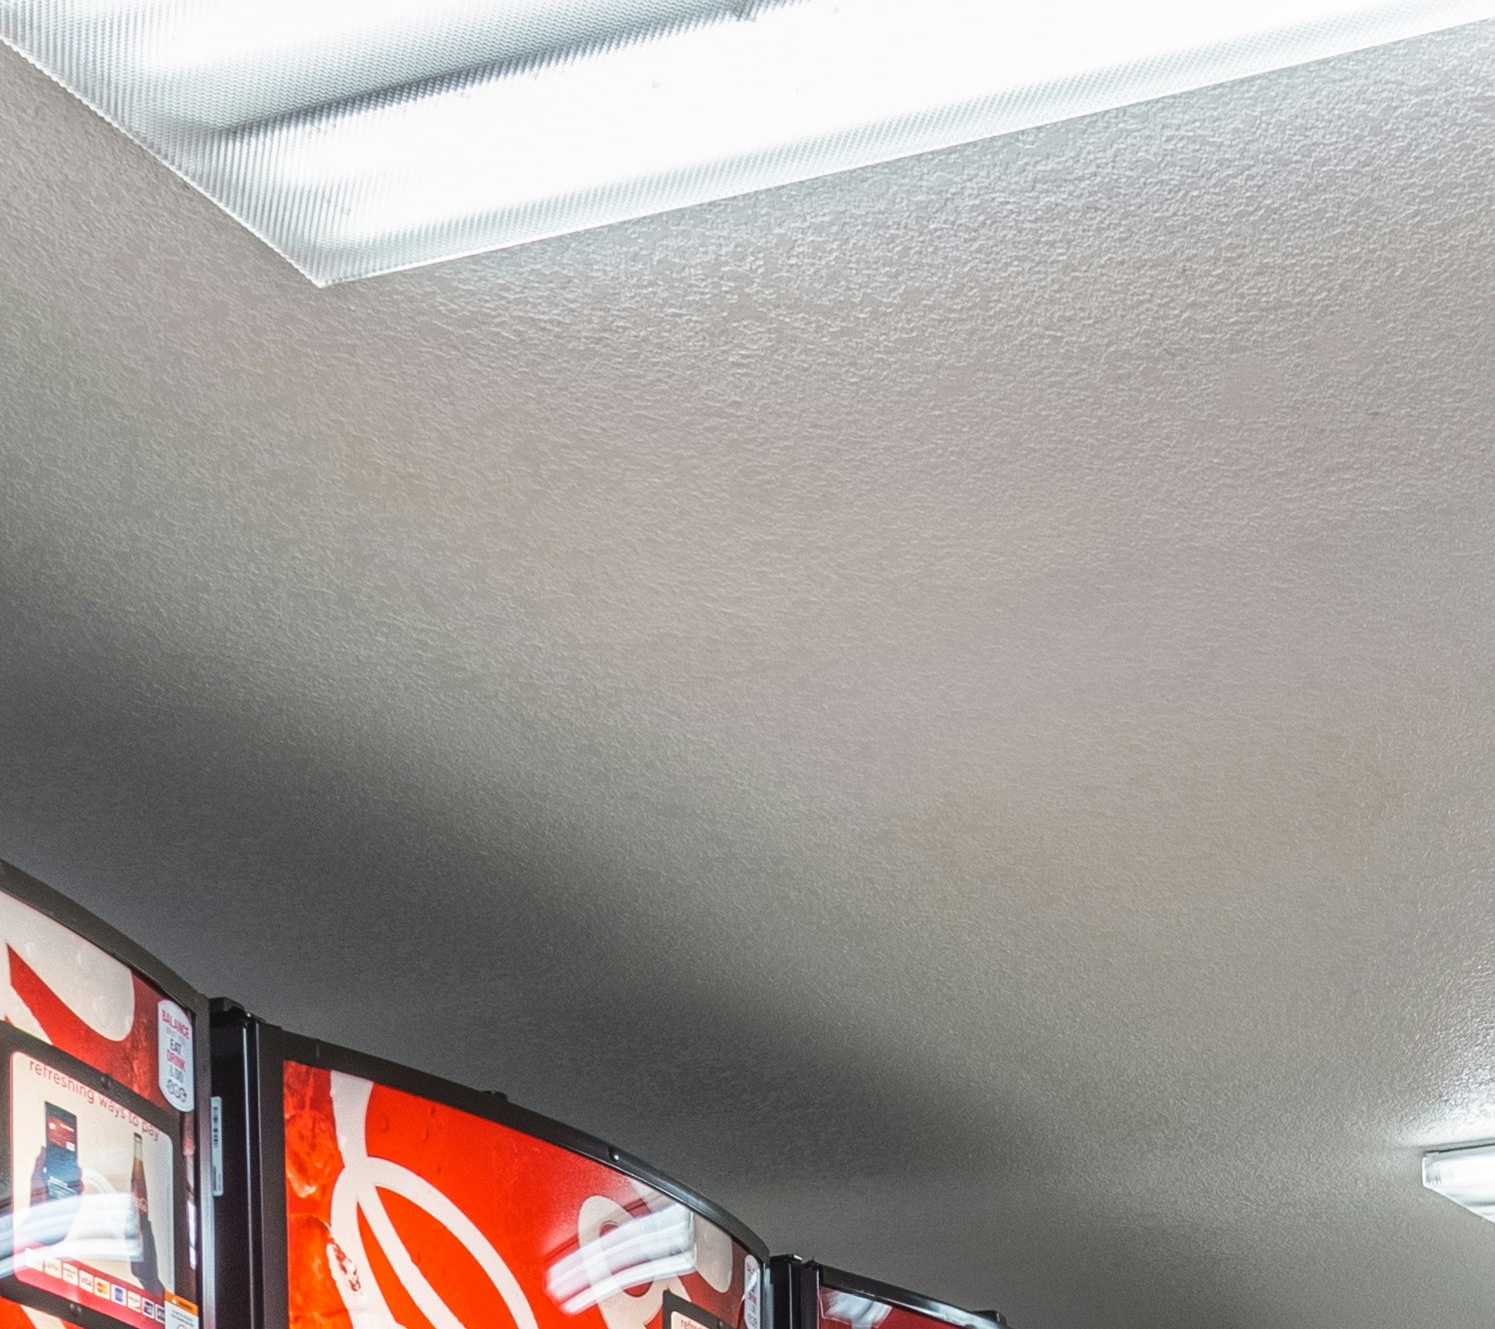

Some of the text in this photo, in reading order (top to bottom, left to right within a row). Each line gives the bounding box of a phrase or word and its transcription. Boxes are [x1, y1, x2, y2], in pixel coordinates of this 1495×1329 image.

[28, 1059, 160, 1142] refreshing ways to pay
